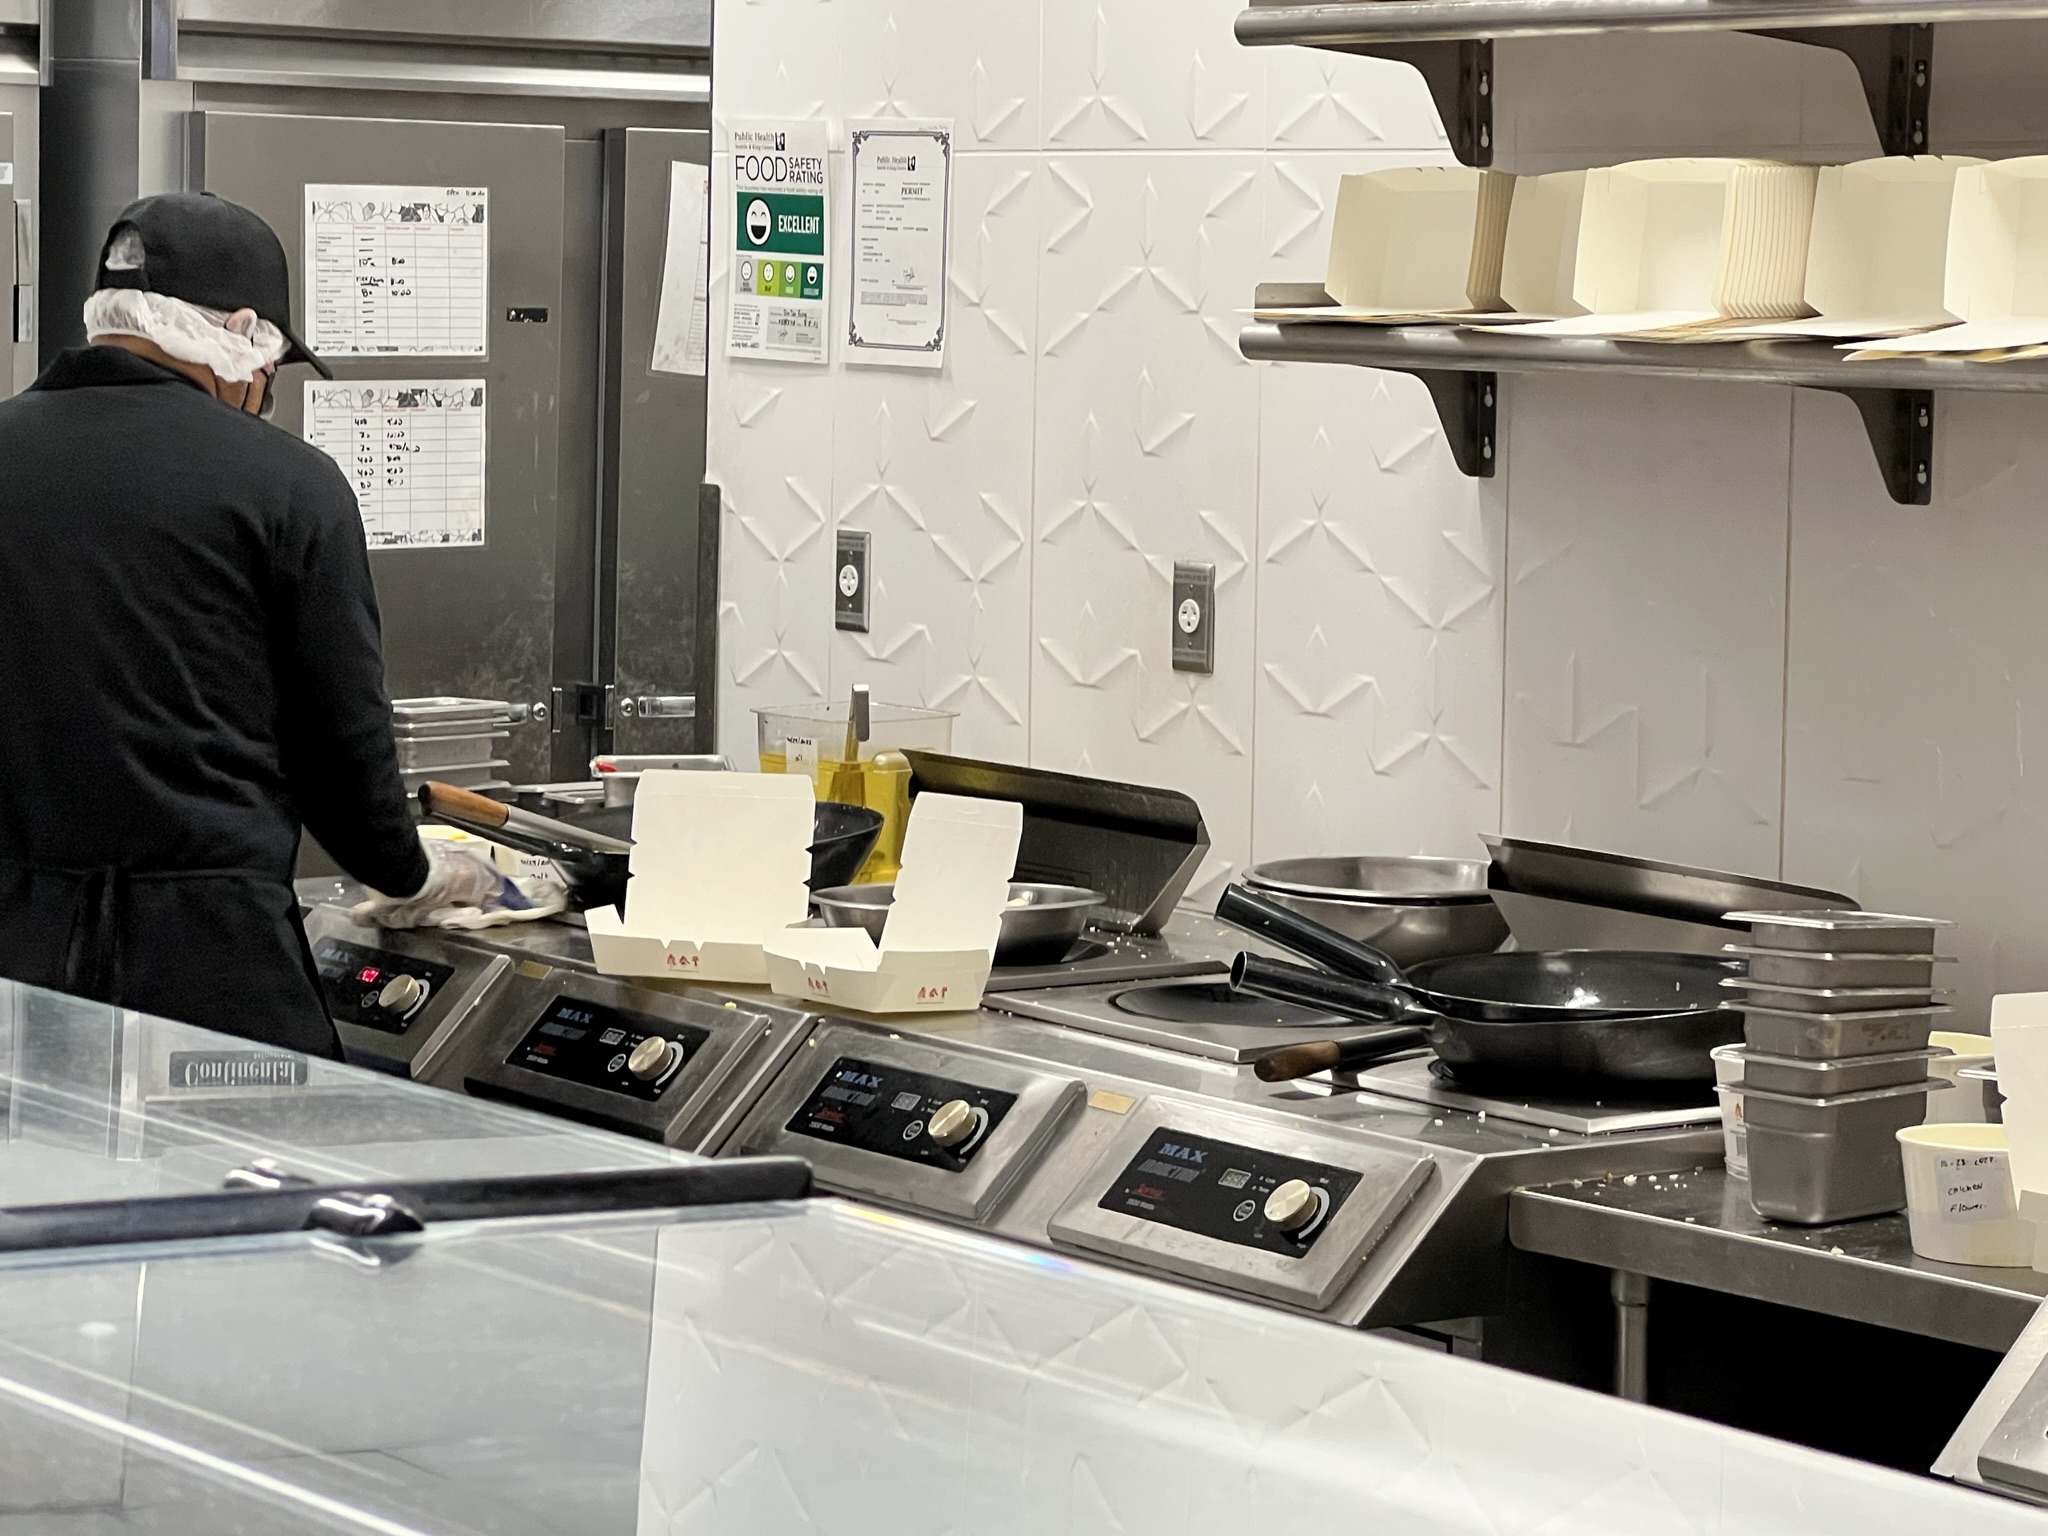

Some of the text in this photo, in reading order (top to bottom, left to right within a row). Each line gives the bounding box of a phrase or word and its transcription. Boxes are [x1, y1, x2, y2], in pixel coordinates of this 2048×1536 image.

[734, 131, 774, 142] Public Health
[735, 155, 788, 182] FOOD
[789, 157, 822, 169] SAFETY
[789, 170, 823, 184] RATING
[901, 187, 923, 196] PERMIT
[778, 215, 820, 234] EXCELLENT
[557, 1008, 594, 1024] MAX
[840, 1071, 884, 1089] MAX
[1157, 1142, 1209, 1163] MAX
